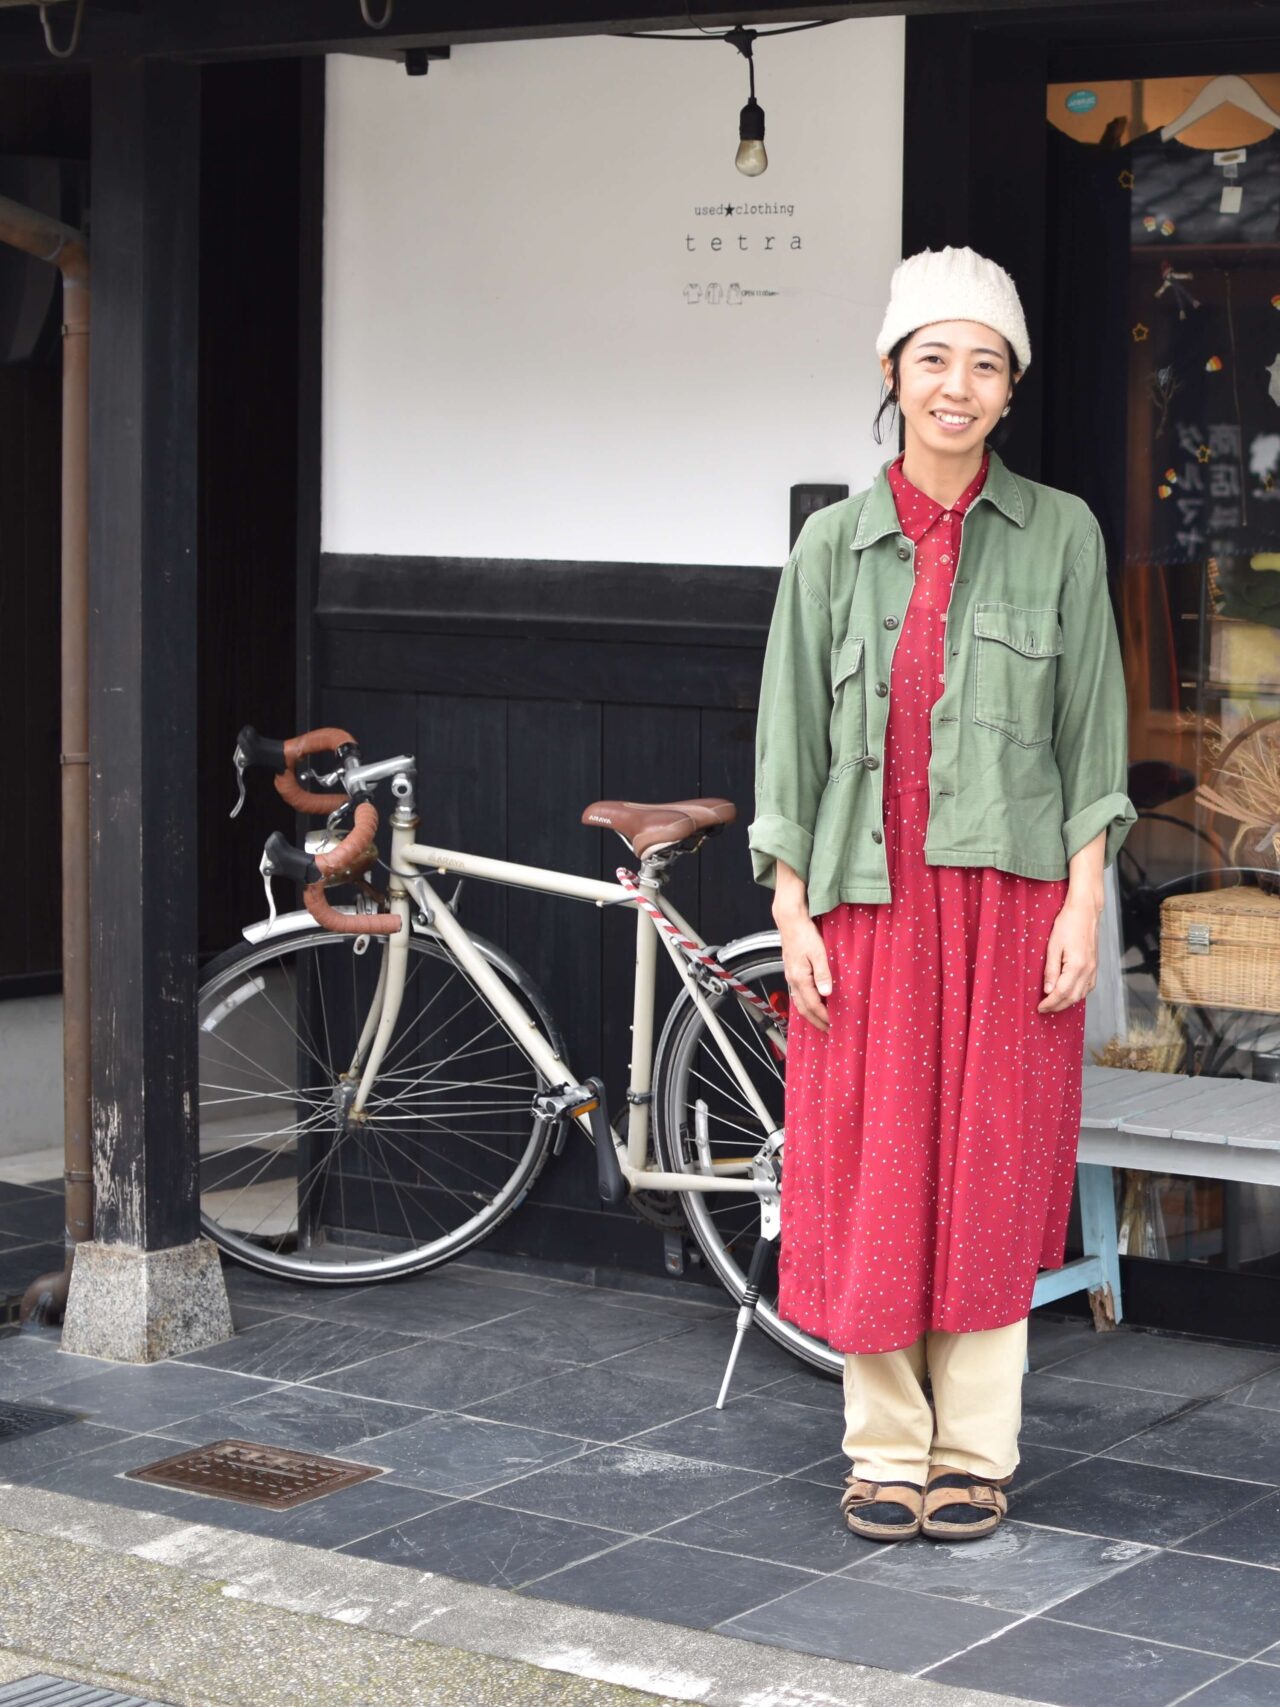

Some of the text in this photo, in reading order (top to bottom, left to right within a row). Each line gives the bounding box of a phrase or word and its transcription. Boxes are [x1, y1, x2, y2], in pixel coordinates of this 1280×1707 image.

[694, 202, 795, 217] used clothing
[685, 233, 802, 252] tetra
